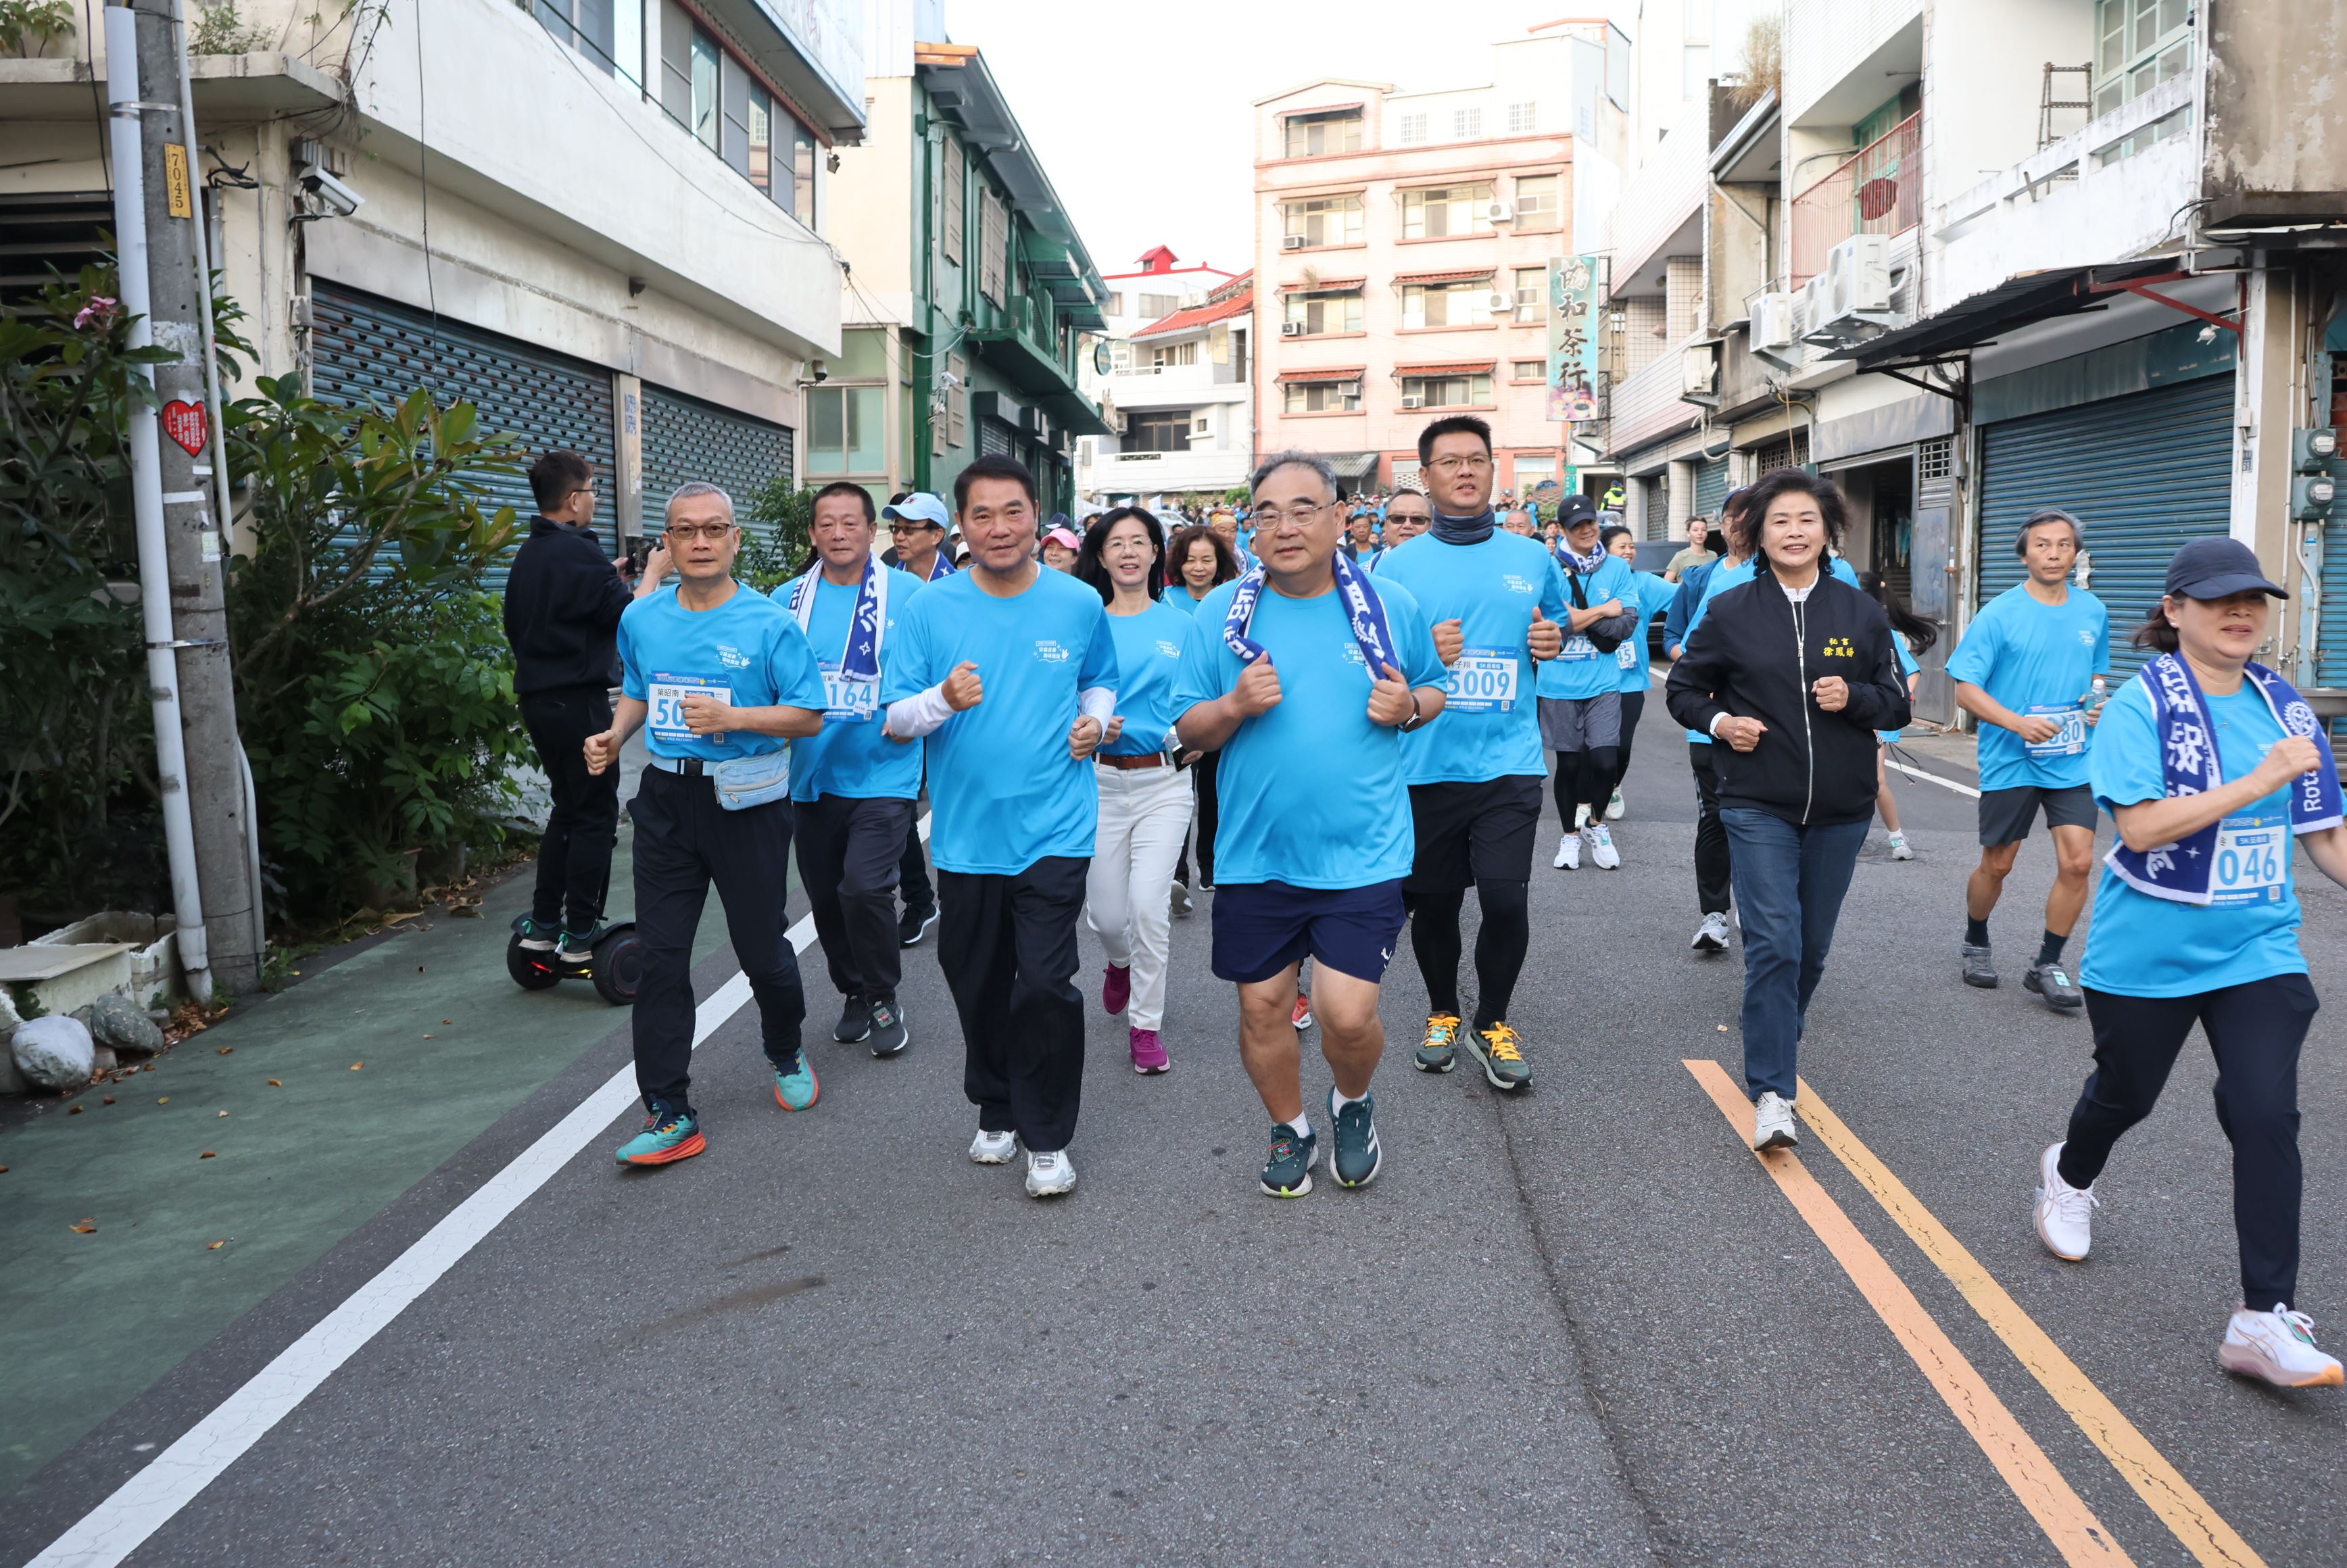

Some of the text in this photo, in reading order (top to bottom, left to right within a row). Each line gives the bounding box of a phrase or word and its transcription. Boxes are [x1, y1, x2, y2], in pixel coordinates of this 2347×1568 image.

[172, 153, 183, 207] 7045
[1557, 259, 1590, 391] 協和茶行
[657, 688, 679, 697] 葉昭南
[1447, 670, 1510, 697] 5009
